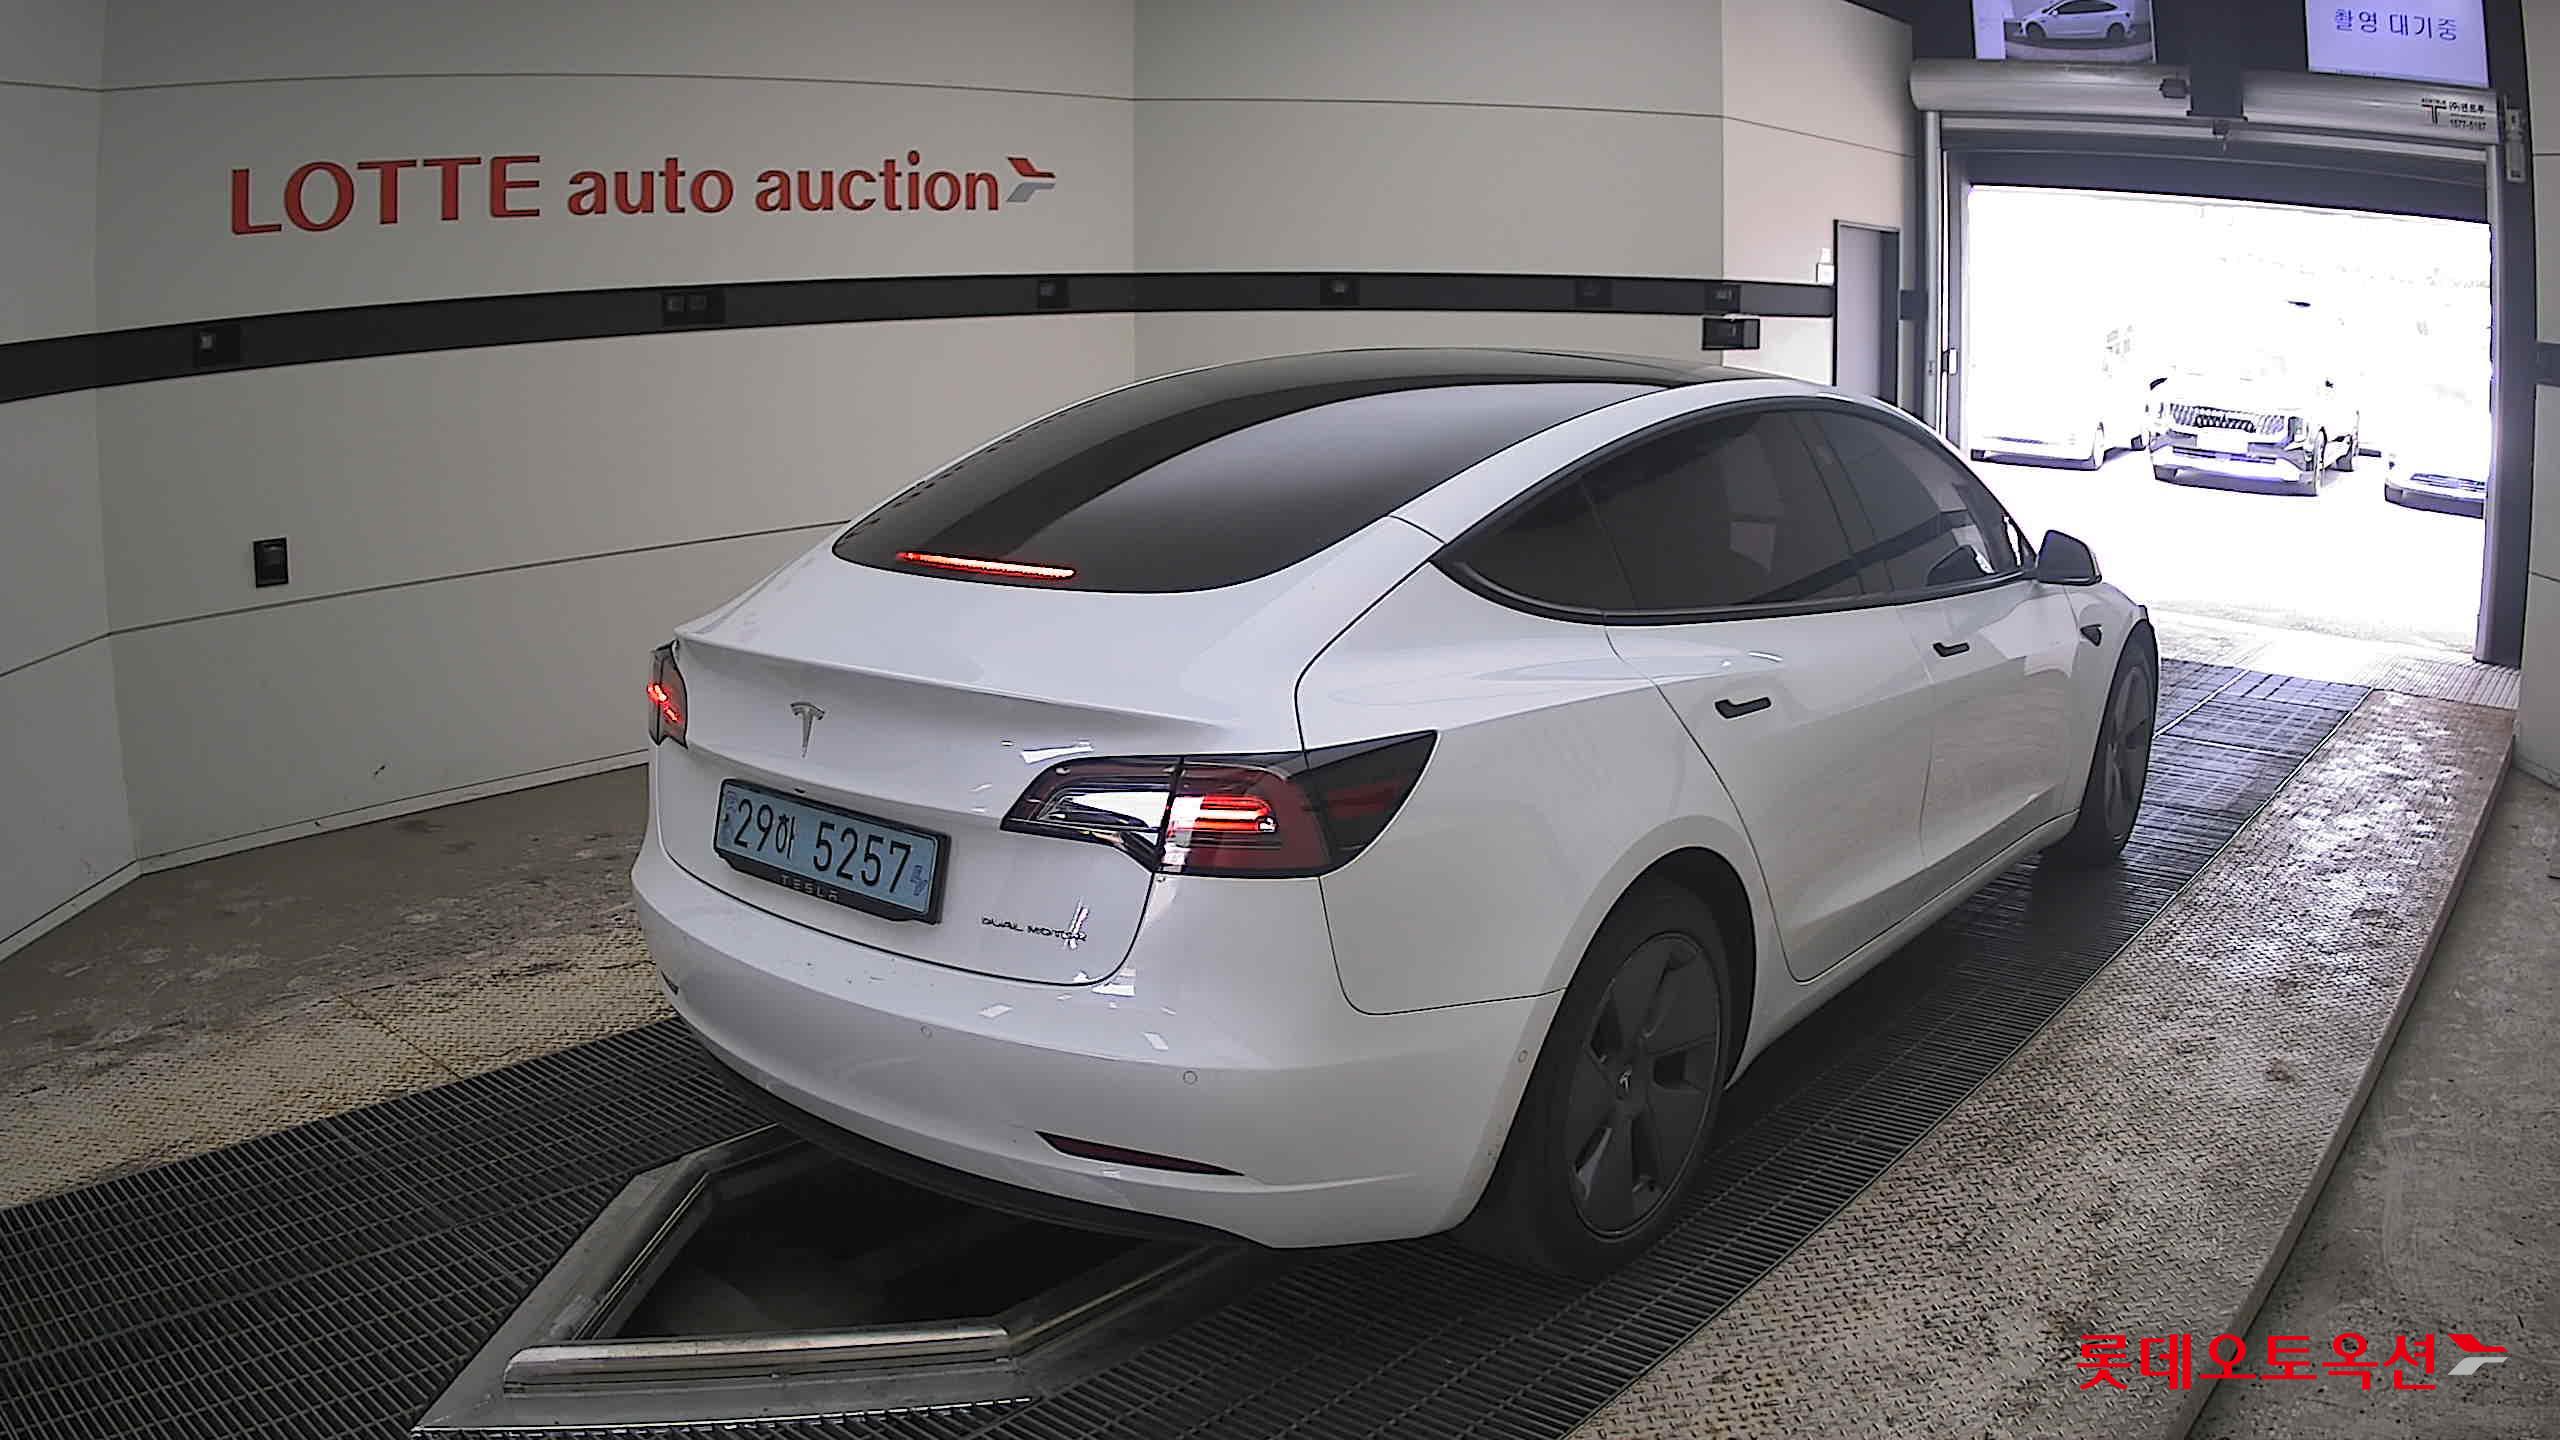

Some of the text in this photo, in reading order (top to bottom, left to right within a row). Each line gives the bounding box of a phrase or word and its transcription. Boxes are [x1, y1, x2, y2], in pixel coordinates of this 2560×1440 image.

[2389, 13, 2457, 41] 대기중
[231, 150, 1000, 236] LOTTE auto auction
[733, 799, 912, 893] 29하 5257
[781, 874, 838, 901] TESLA
[982, 917, 1087, 942] DUAL MOTOR
